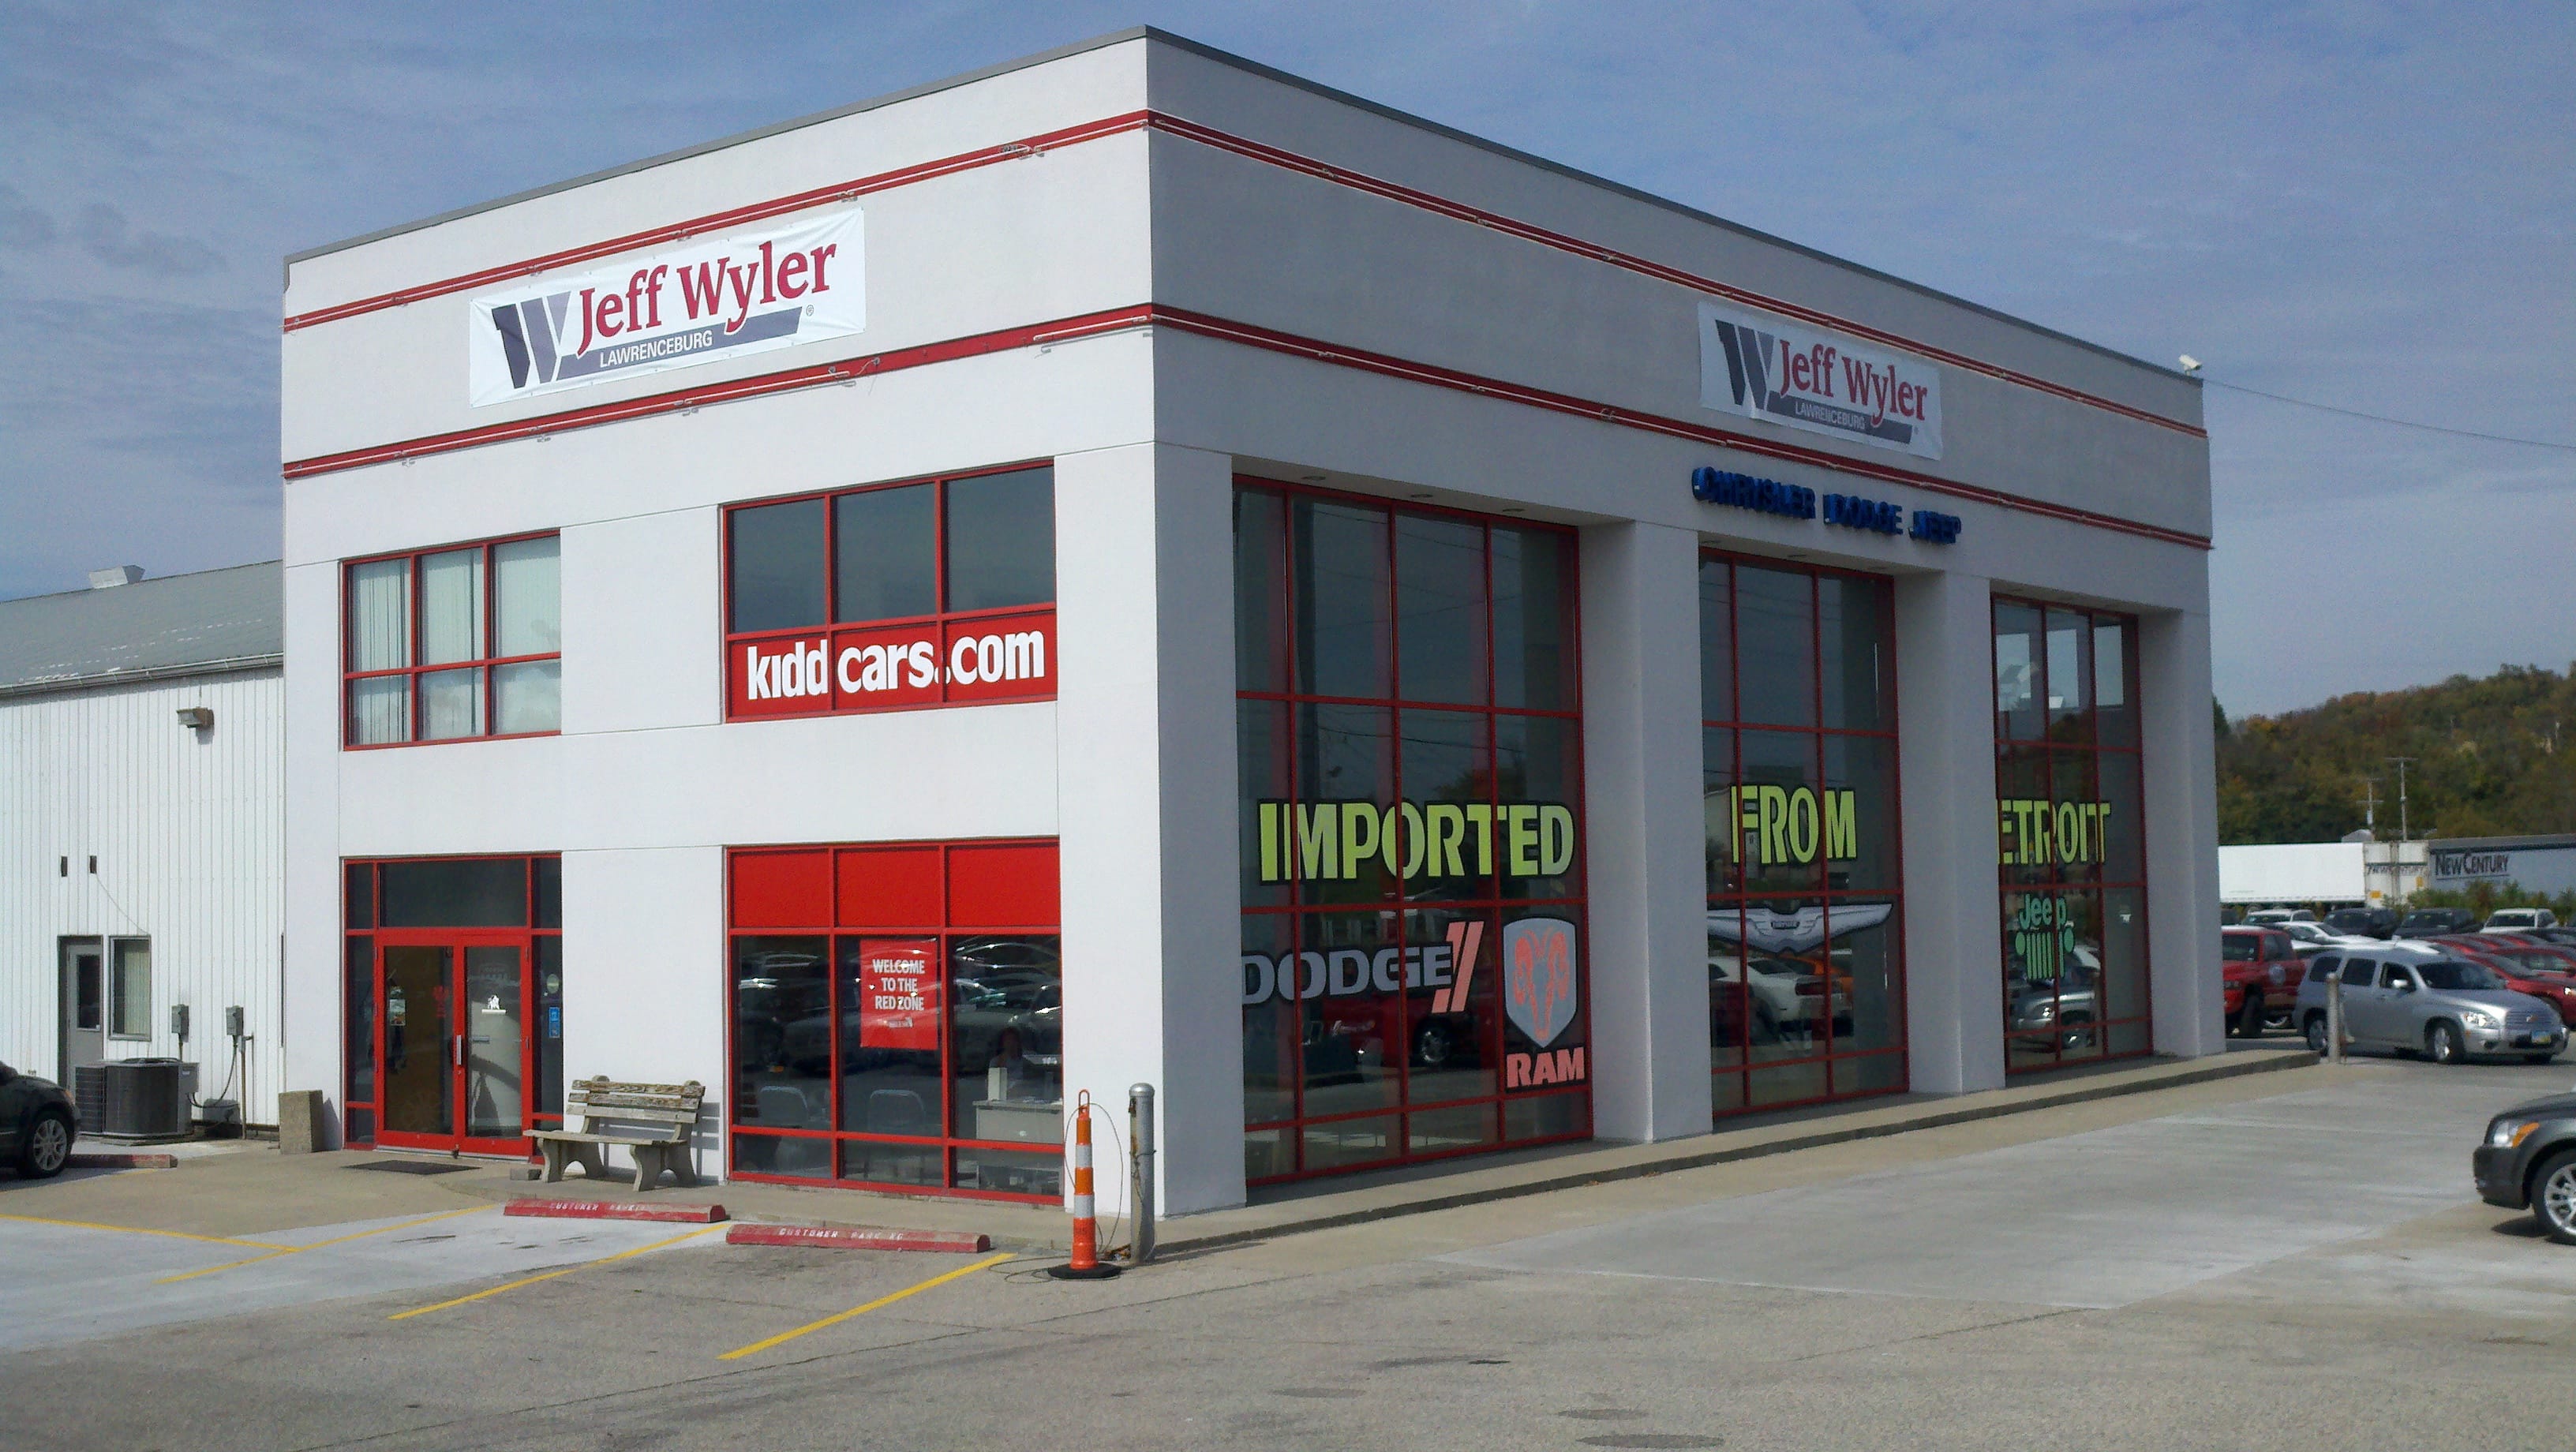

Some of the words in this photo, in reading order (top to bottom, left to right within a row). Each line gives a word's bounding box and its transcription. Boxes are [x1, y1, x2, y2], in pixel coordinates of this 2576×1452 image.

[577, 264, 668, 355] Jeff
[676, 240, 837, 335] Wyler
[599, 330, 713, 369] LAWRENCEBURG
[1779, 339, 1836, 397] Jeff
[1841, 355, 1928, 426] Wyler
[1795, 401, 1866, 430] LAWRENCEBURG
[1259, 801, 1575, 882] IMPORTED
[1731, 784, 1857, 864] FROM
[1996, 799, 2111, 865] ETROIT
[2019, 893, 2067, 930] Jeep
[872, 958, 926, 975] WELCOME
[881, 977, 896, 992] TO
[897, 978, 918, 992] THE
[1242, 945, 1454, 1005] DODGE
[874, 995, 896, 1010] RED
[897, 996, 925, 1011] ZONE
[1507, 1047, 1585, 1088] RAM
